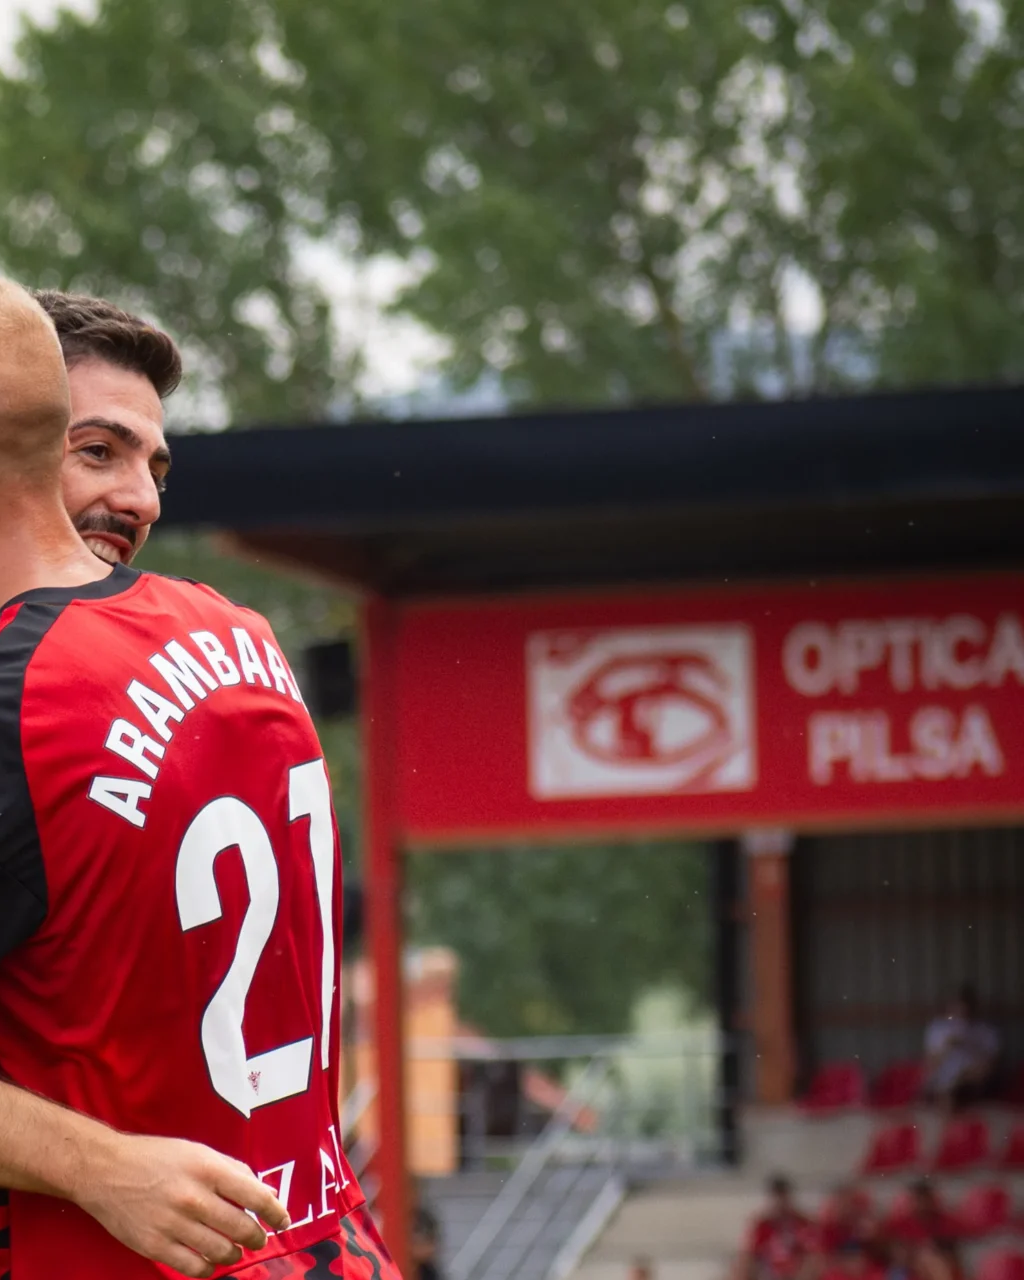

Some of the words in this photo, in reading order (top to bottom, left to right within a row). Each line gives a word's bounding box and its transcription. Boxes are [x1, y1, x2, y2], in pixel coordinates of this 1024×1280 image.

[782, 613, 1024, 696] OPTICA
[87, 626, 309, 830] ARAMBAR
[808, 705, 1004, 785] PILSA
[175, 758, 335, 1119] 21
